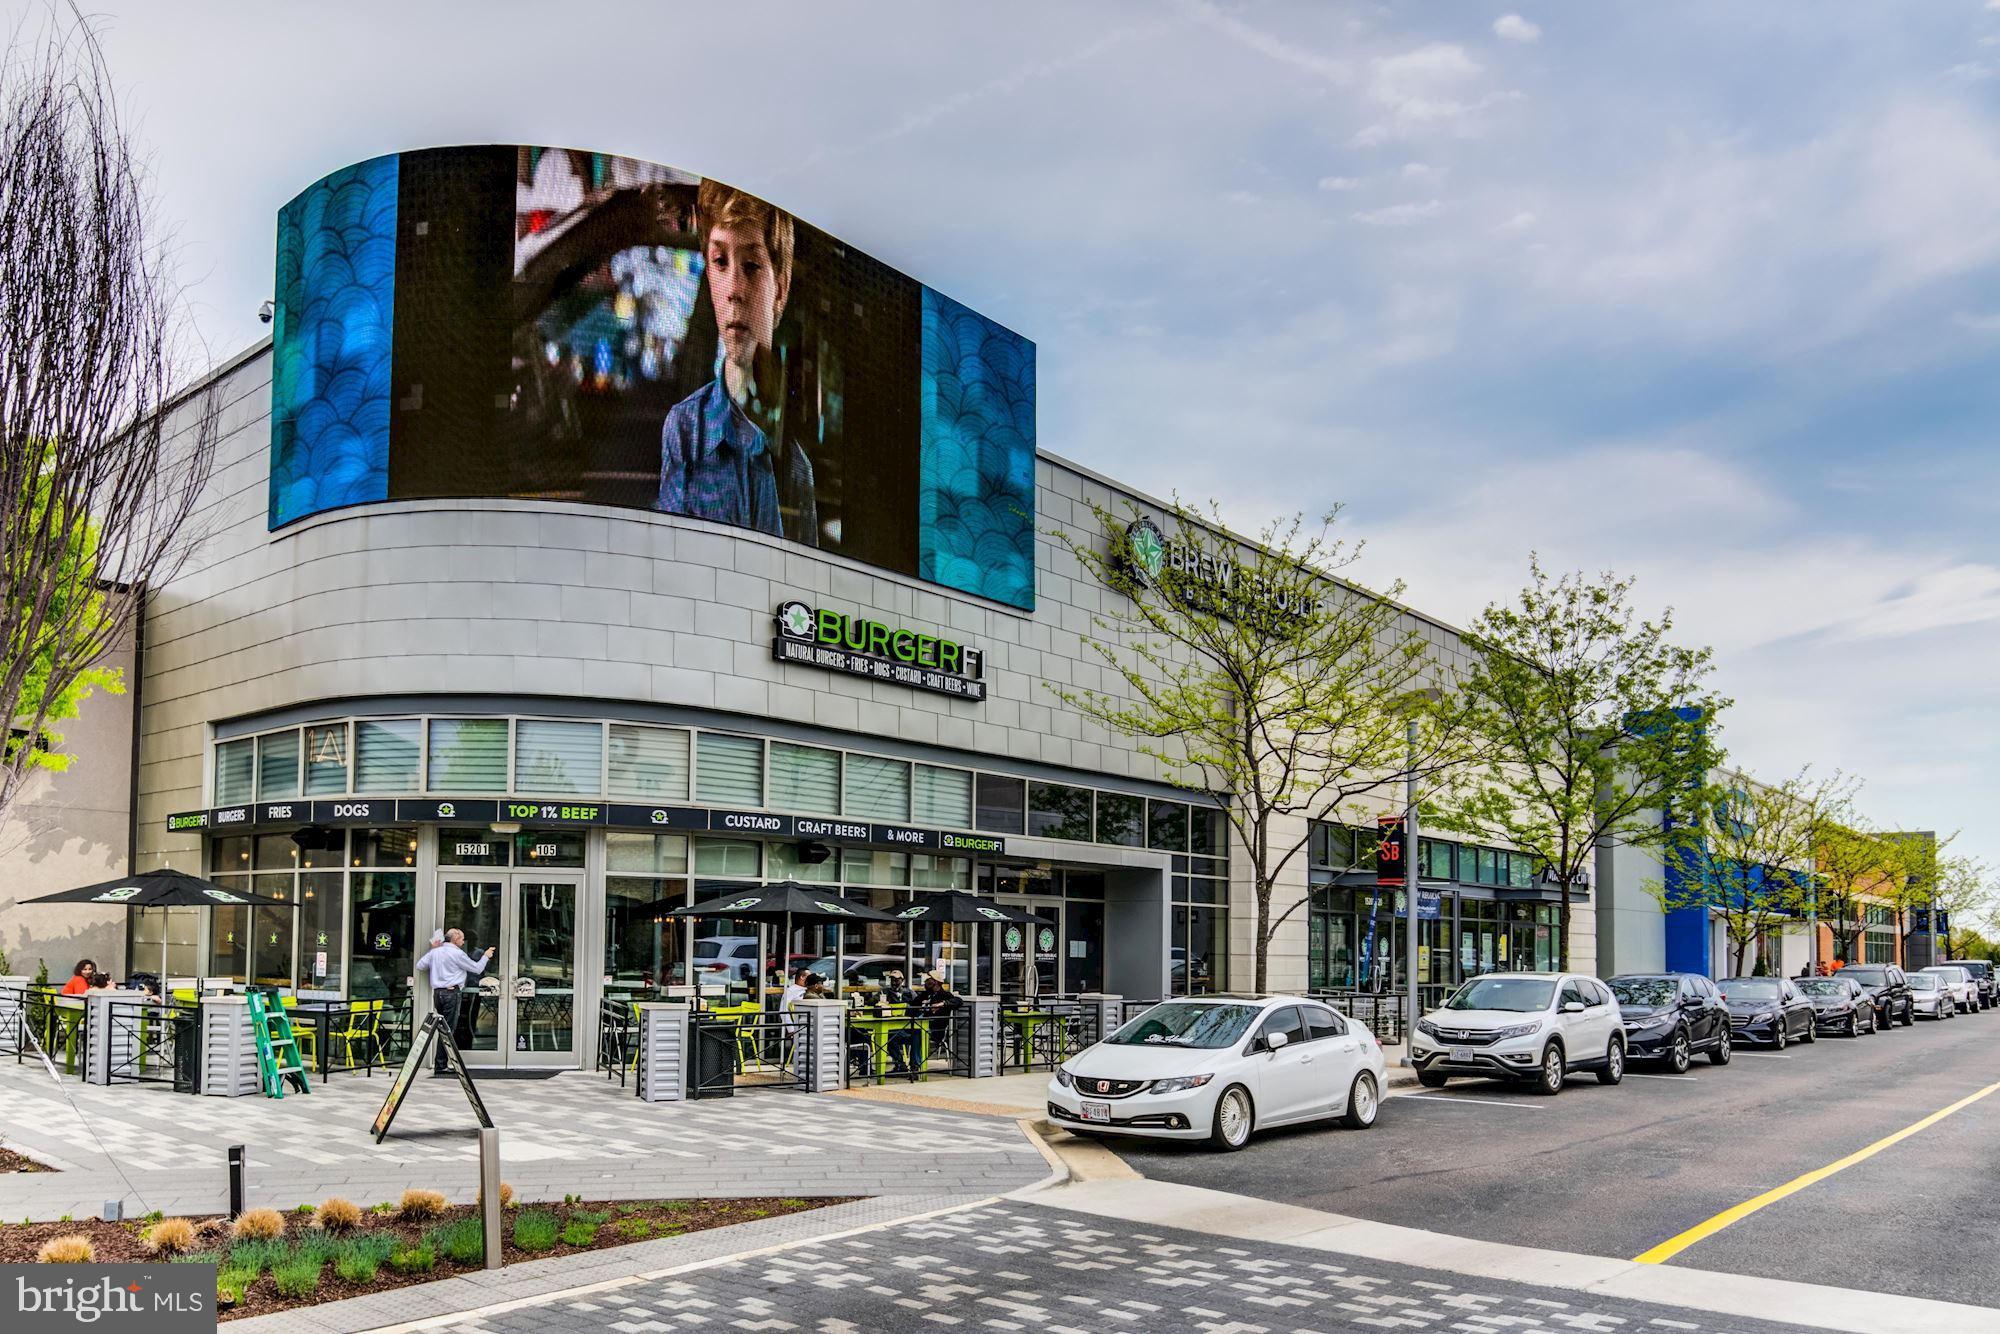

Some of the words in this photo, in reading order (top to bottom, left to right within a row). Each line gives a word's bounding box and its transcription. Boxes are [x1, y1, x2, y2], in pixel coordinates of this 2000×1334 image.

[1169, 542, 1233, 590] BREW
[785, 642, 815, 662] NATURAL
[816, 648, 845, 669] BURGERS
[850, 657, 869, 674] FRIES
[873, 662, 891, 678] DOGS
[895, 667, 922, 685] CUSTARD
[926, 673, 944, 689] CRAFT
[944, 677, 962, 693] BEERS
[966, 682, 981, 697] WINE
[217, 809, 246, 823] BURGERS
[268, 805, 293, 819] FRIES
[334, 804, 370, 818] DOGS
[508, 804, 538, 818] TOP
[540, 805, 558, 819] 1%
[561, 806, 599, 820] BEEF
[175, 814, 208, 829] BURGERFI
[725, 814, 781, 830] CUSTARD
[797, 820, 833, 835] CRAFT
[834, 823, 867, 838] BEERS
[887, 829, 895, 841] &
[896, 830, 924, 844] MORE
[954, 836, 1003, 851] BURGERFI
[456, 843, 489, 855] 15201
[537, 845, 556, 856] 105
[1380, 841, 1400, 861] SB
